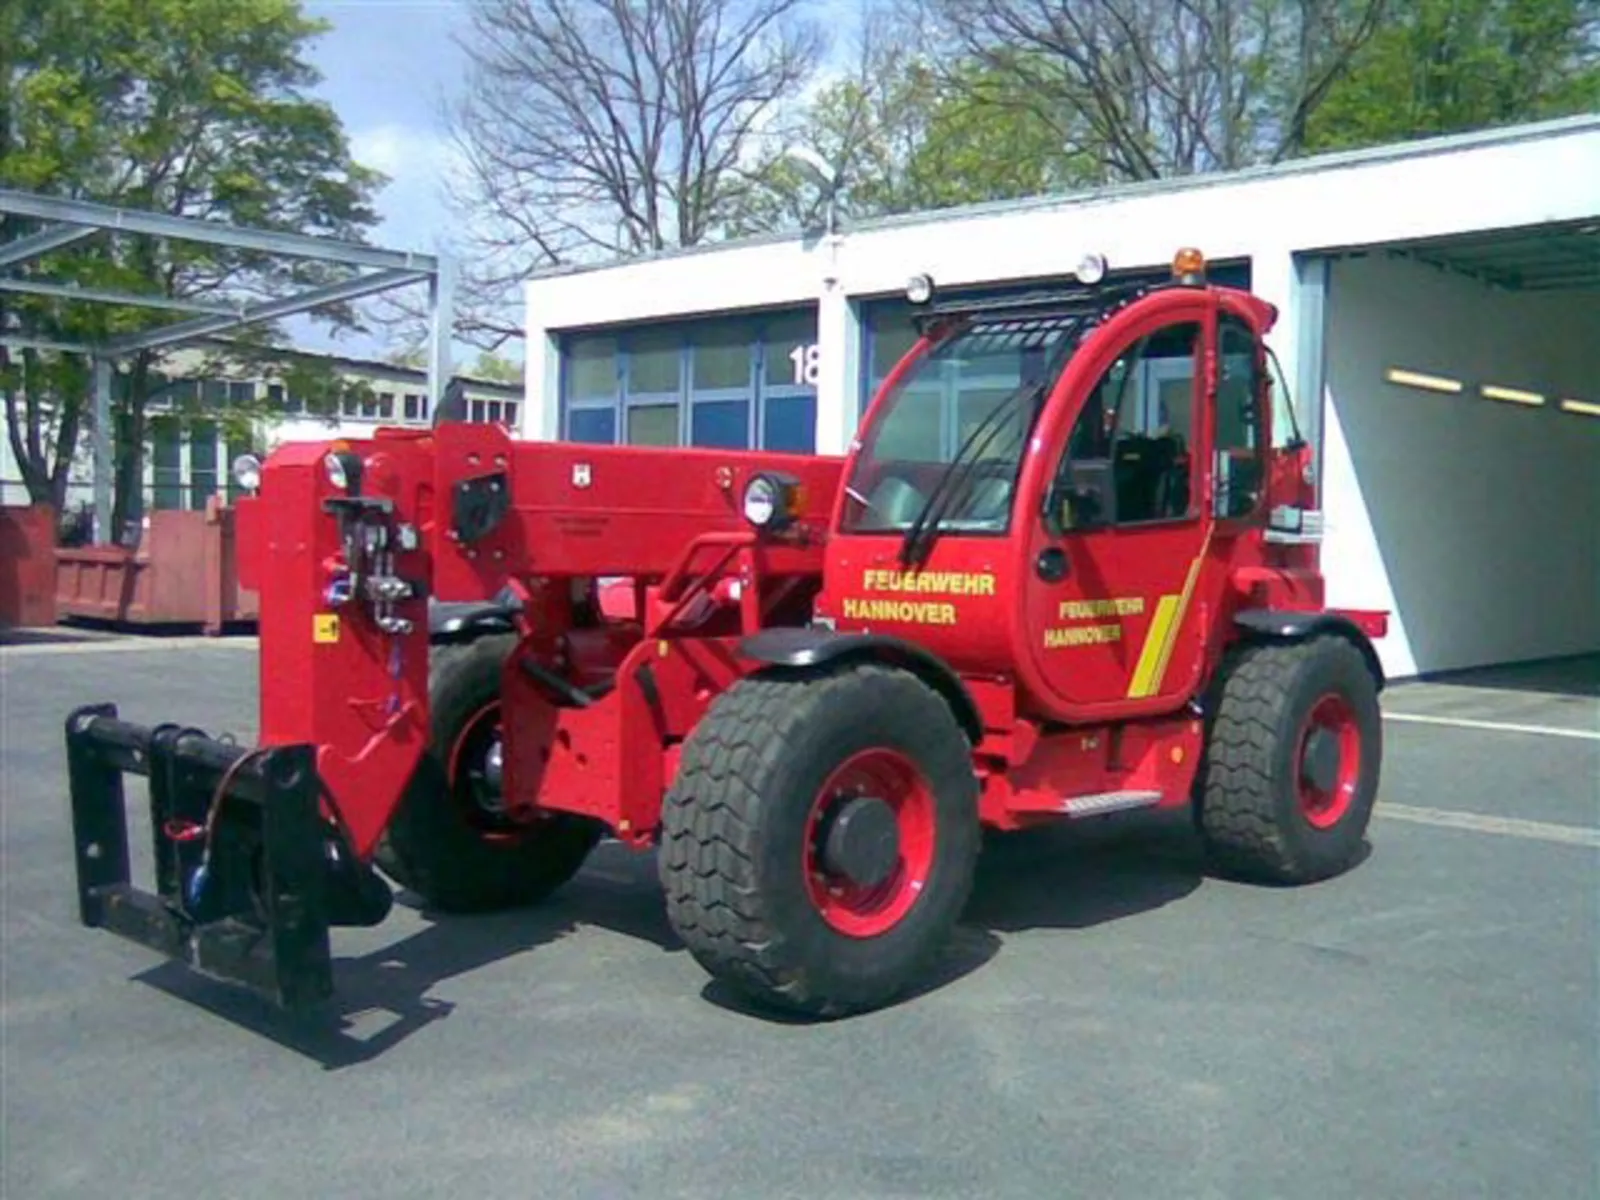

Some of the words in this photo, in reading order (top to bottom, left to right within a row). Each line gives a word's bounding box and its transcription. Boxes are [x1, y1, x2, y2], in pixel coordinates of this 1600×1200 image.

[789, 344, 820, 385] 18
[863, 569, 995, 595] FEUERWEHR
[843, 599, 956, 625] HANNOVER
[1059, 597, 1145, 620] FEUERWEHR
[1043, 624, 1122, 648] HANNOVER
